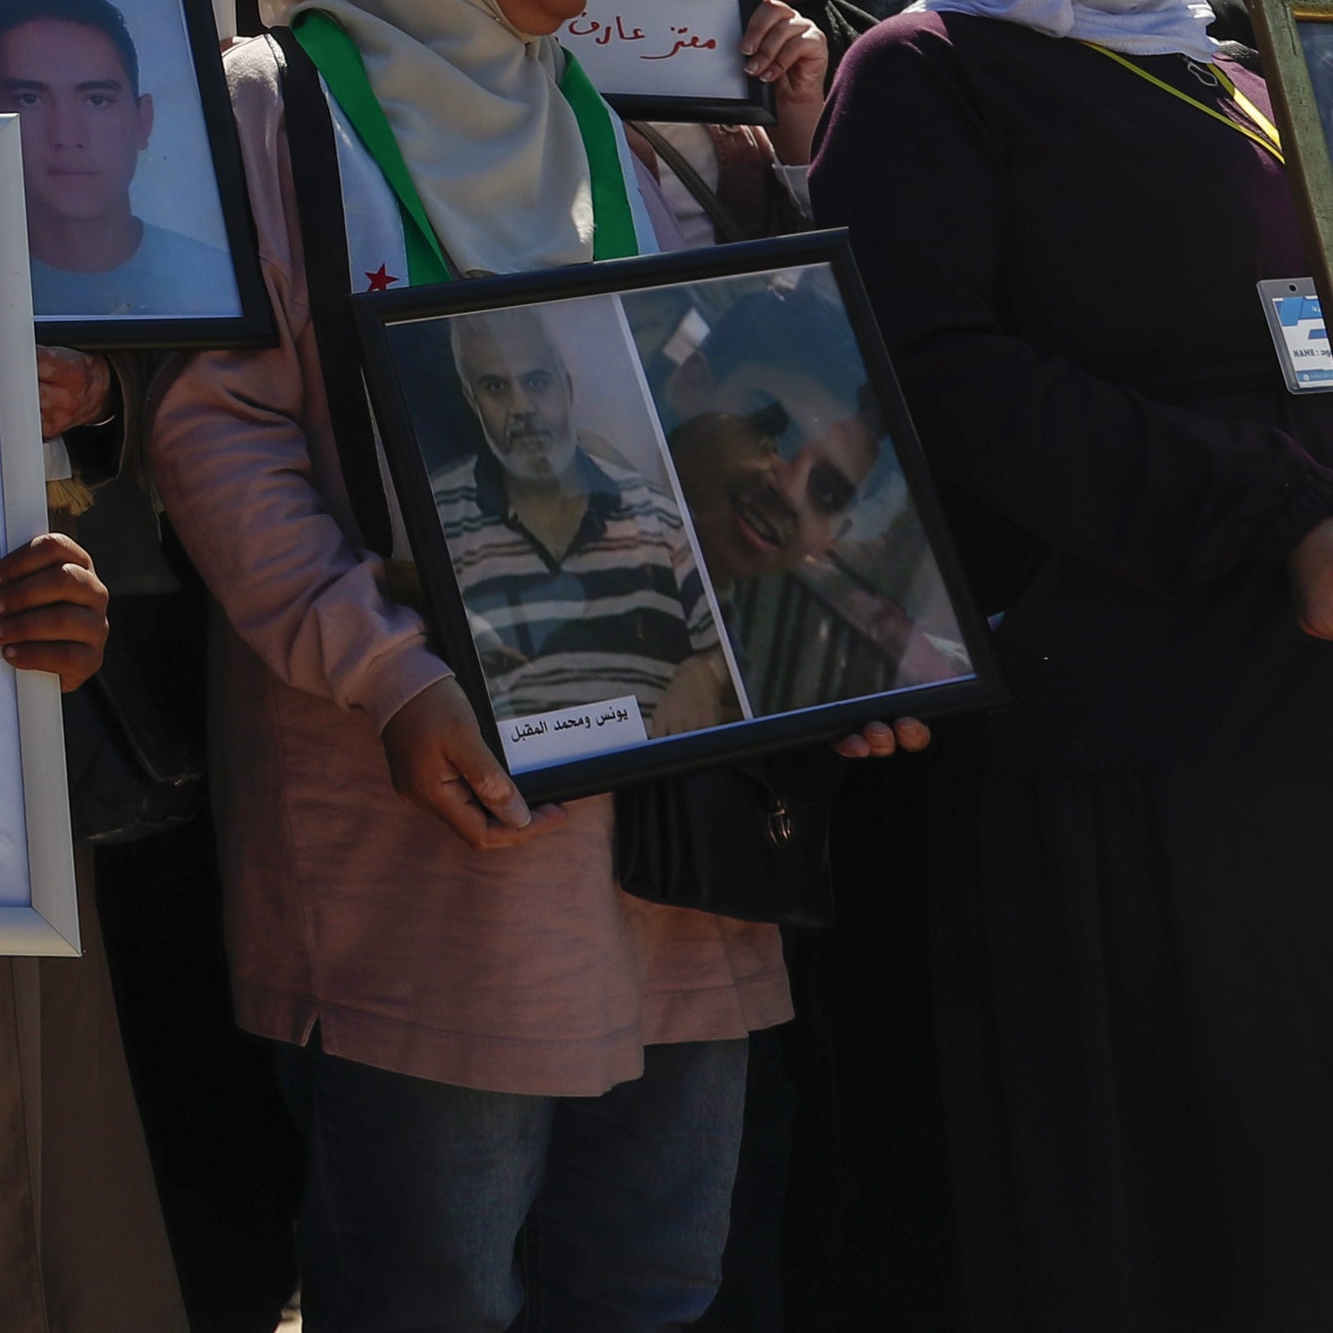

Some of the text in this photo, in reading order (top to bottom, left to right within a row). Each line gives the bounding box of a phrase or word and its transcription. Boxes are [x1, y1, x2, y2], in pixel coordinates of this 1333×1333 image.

[568, 11, 717, 59] معتز عارف
[595, 706, 629, 727] يونس
[511, 721, 549, 743] المقبل
